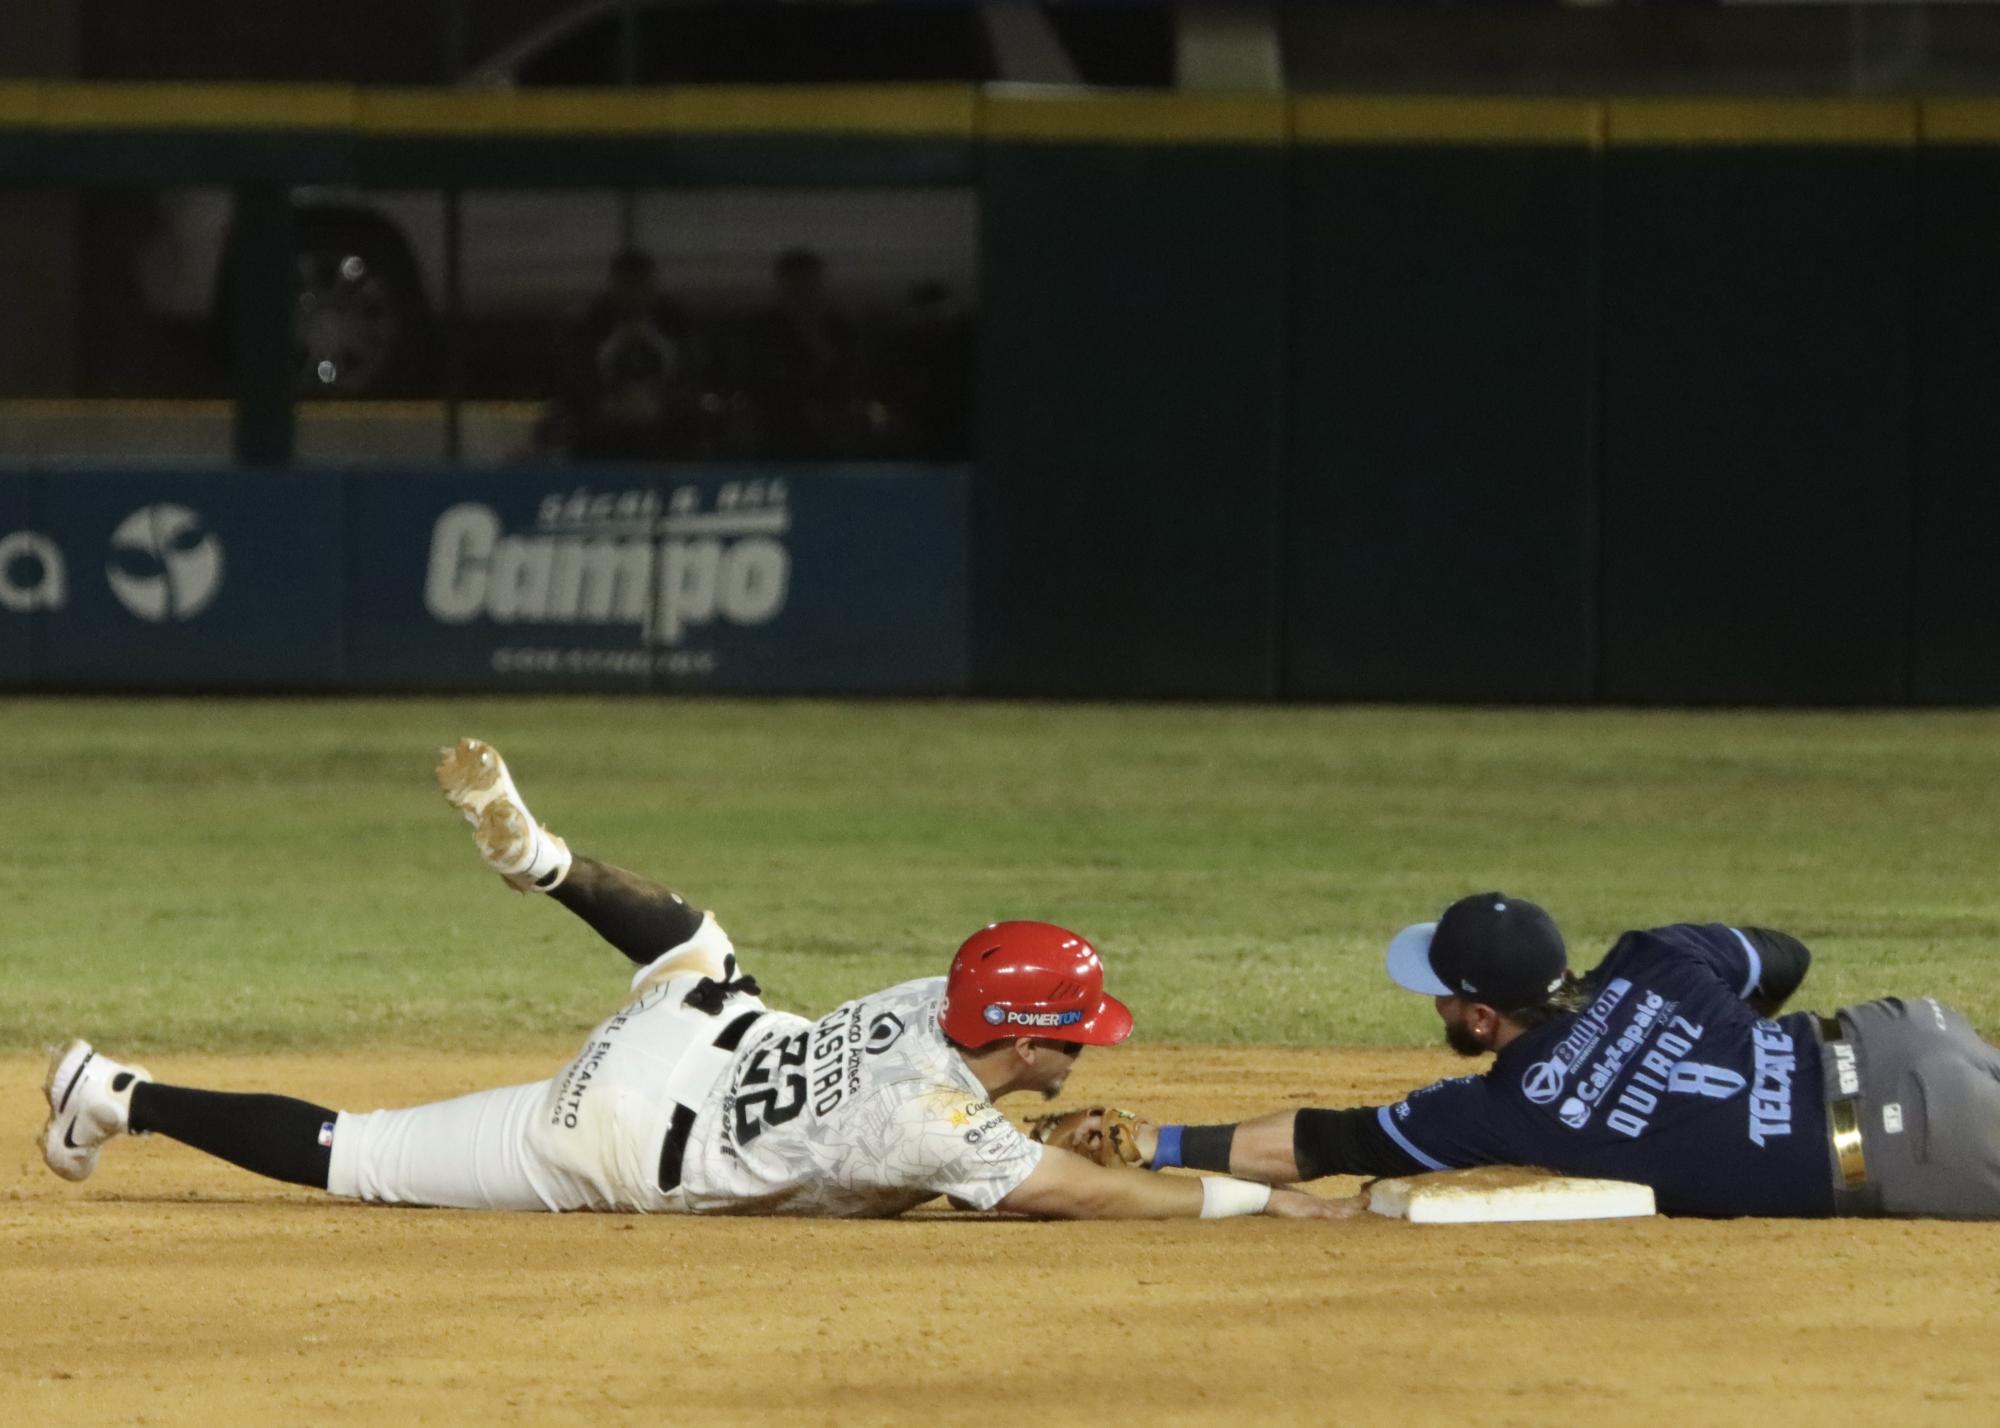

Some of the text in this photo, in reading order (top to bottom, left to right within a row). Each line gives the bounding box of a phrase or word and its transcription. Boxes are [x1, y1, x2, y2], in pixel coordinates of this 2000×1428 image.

[426, 502, 790, 645] Campo
[564, 1041, 612, 1130] ENCANTO
[736, 1031, 810, 1147] 22
[814, 1007, 850, 1117] CASTRO
[1606, 1015, 1703, 1138] QUIROZ
[1668, 1061, 1747, 1099] 8
[1749, 1022, 1796, 1148] TECATE
